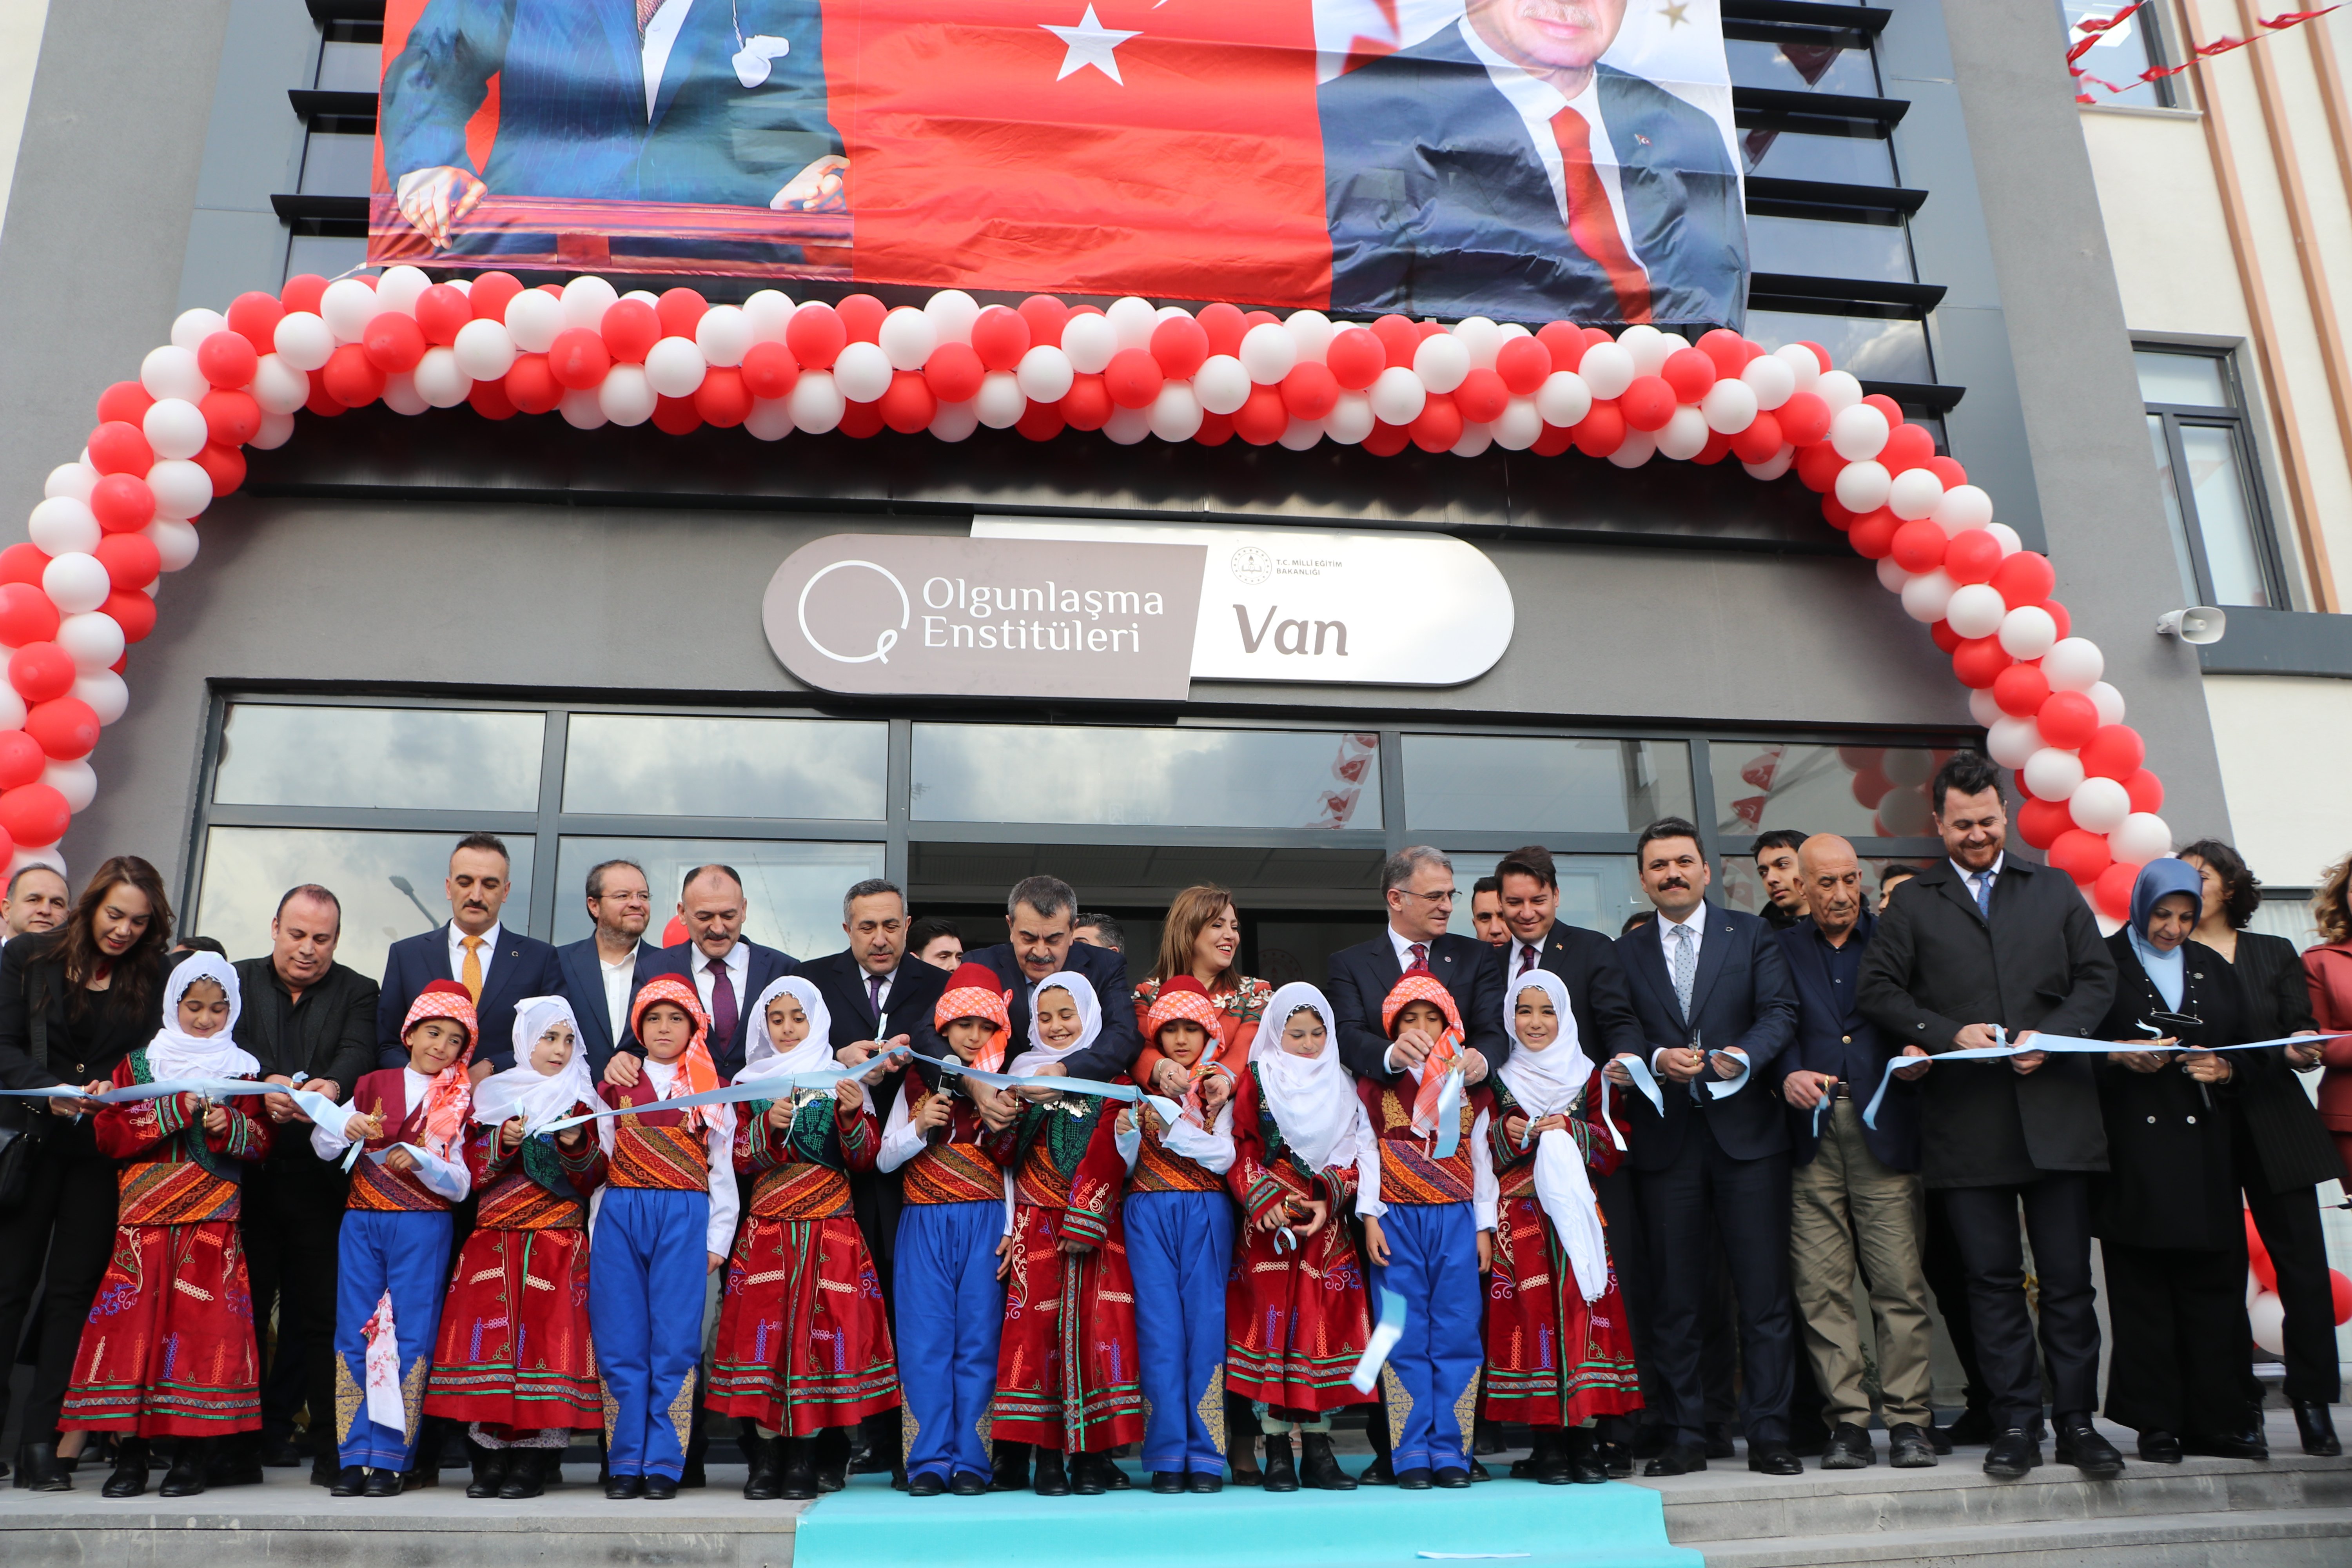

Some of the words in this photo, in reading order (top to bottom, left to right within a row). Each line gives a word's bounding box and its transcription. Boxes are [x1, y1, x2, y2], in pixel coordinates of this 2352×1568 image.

[923, 577, 1163, 620] Olgunlaşma
[921, 615, 1140, 652] Enstitüleri
[1232, 604, 1348, 656] Van
